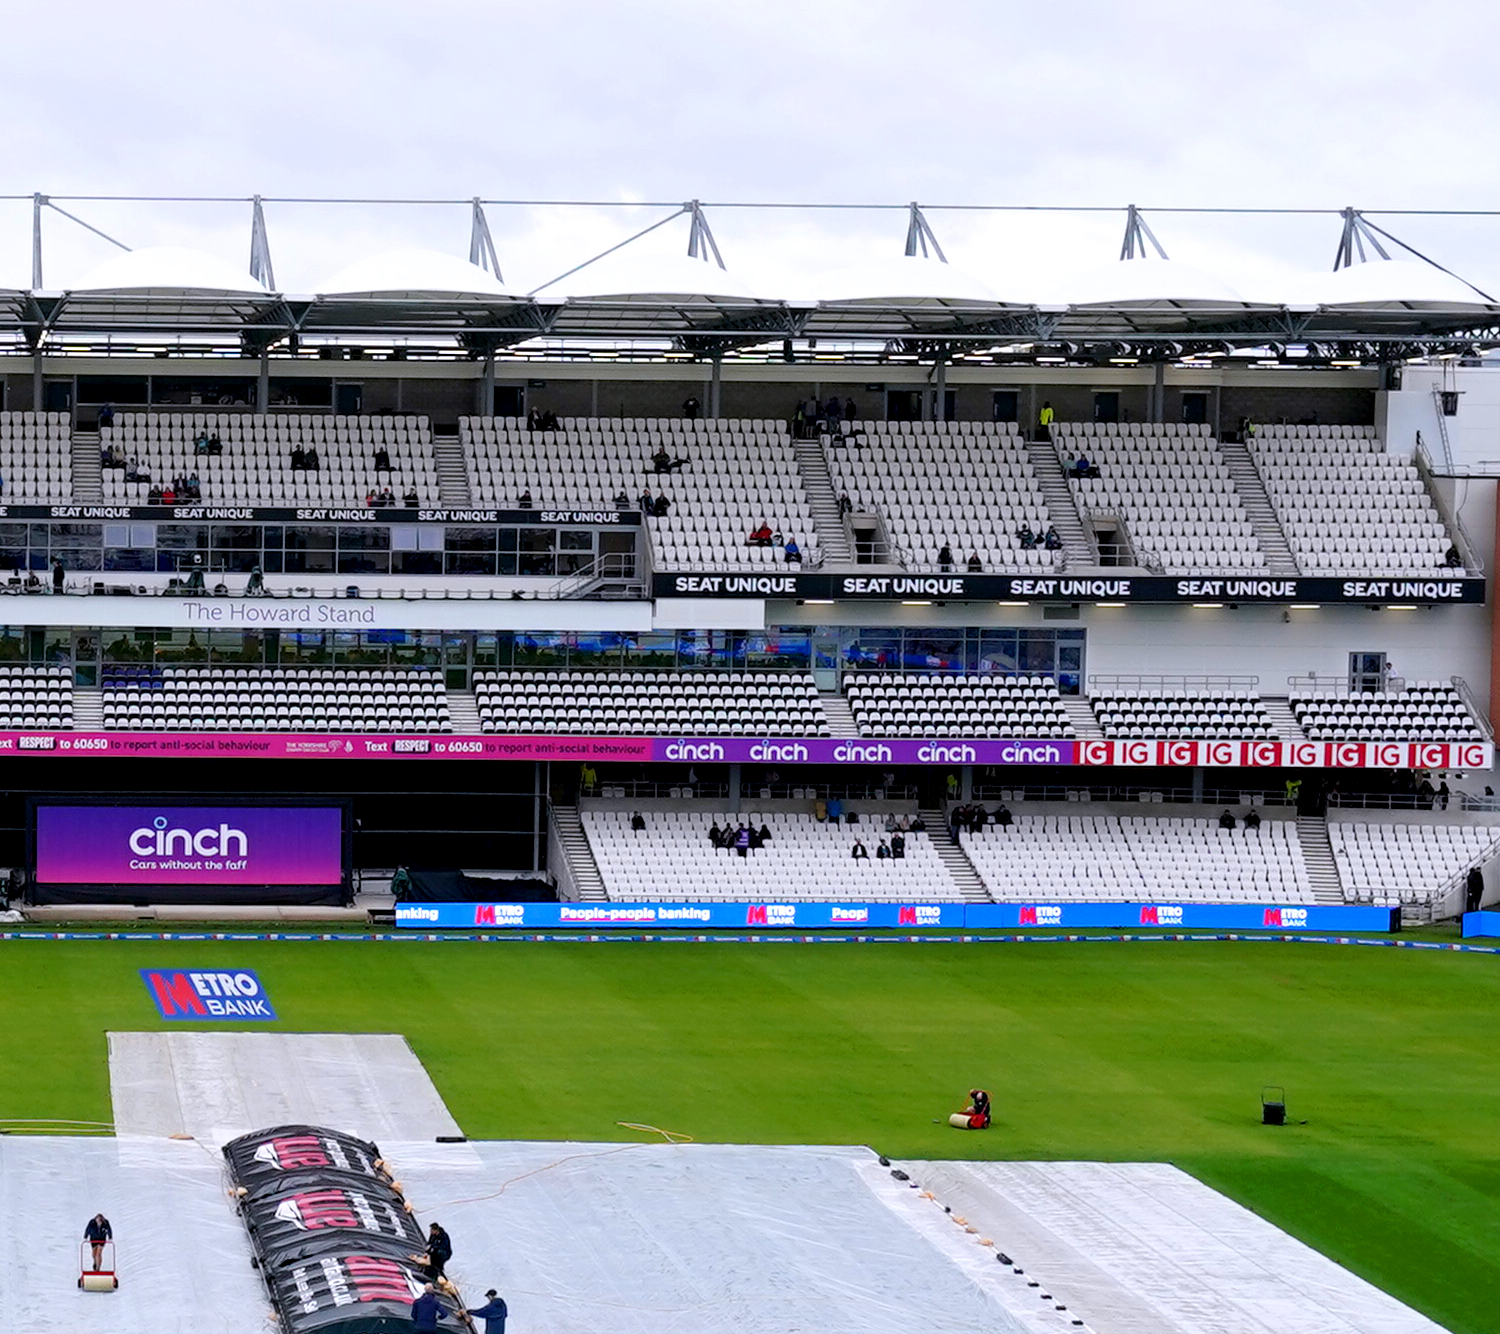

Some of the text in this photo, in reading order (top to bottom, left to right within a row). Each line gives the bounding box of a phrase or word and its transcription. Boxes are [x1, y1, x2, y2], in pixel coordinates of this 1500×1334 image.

[51, 507, 131, 519] SEAT UNIQUE
[541, 512, 620, 523] SEAT UNIQUE
[676, 577, 796, 593] SEAT UNIQUE
[1011, 580, 1130, 596] SEAT UNIQUE
[1343, 582, 1462, 598] SEAT UNIQUE
[183, 603, 375, 623] The Howard Stand
[18, 736, 55, 749] RESPECT
[60, 739, 70, 749] to
[73, 738, 108, 750] 60650
[365, 741, 388, 752] Text
[394, 740, 430, 752] RESPECT
[434, 742, 445, 753] to
[447, 742, 483, 753] 60650
[666, 738, 724, 762] cinch
[833, 738, 891, 762] cinch
[1001, 738, 1059, 762] cinch
[1079, 742, 1108, 764] IG
[1122, 742, 1149, 764] IG
[1291, 744, 1316, 765] IG
[1332, 744, 1359, 765] IG
[1458, 745, 1484, 766] IG
[129, 816, 248, 857] cinch
[130, 859, 248, 871] Cars without the faff
[477, 906, 524, 924] METRO
[497, 917, 523, 926] BANK
[560, 907, 711, 922] People-people banking
[1020, 906, 1061, 923] METRO
[150, 973, 259, 1015] METRO
[206, 999, 271, 1016] BANK
